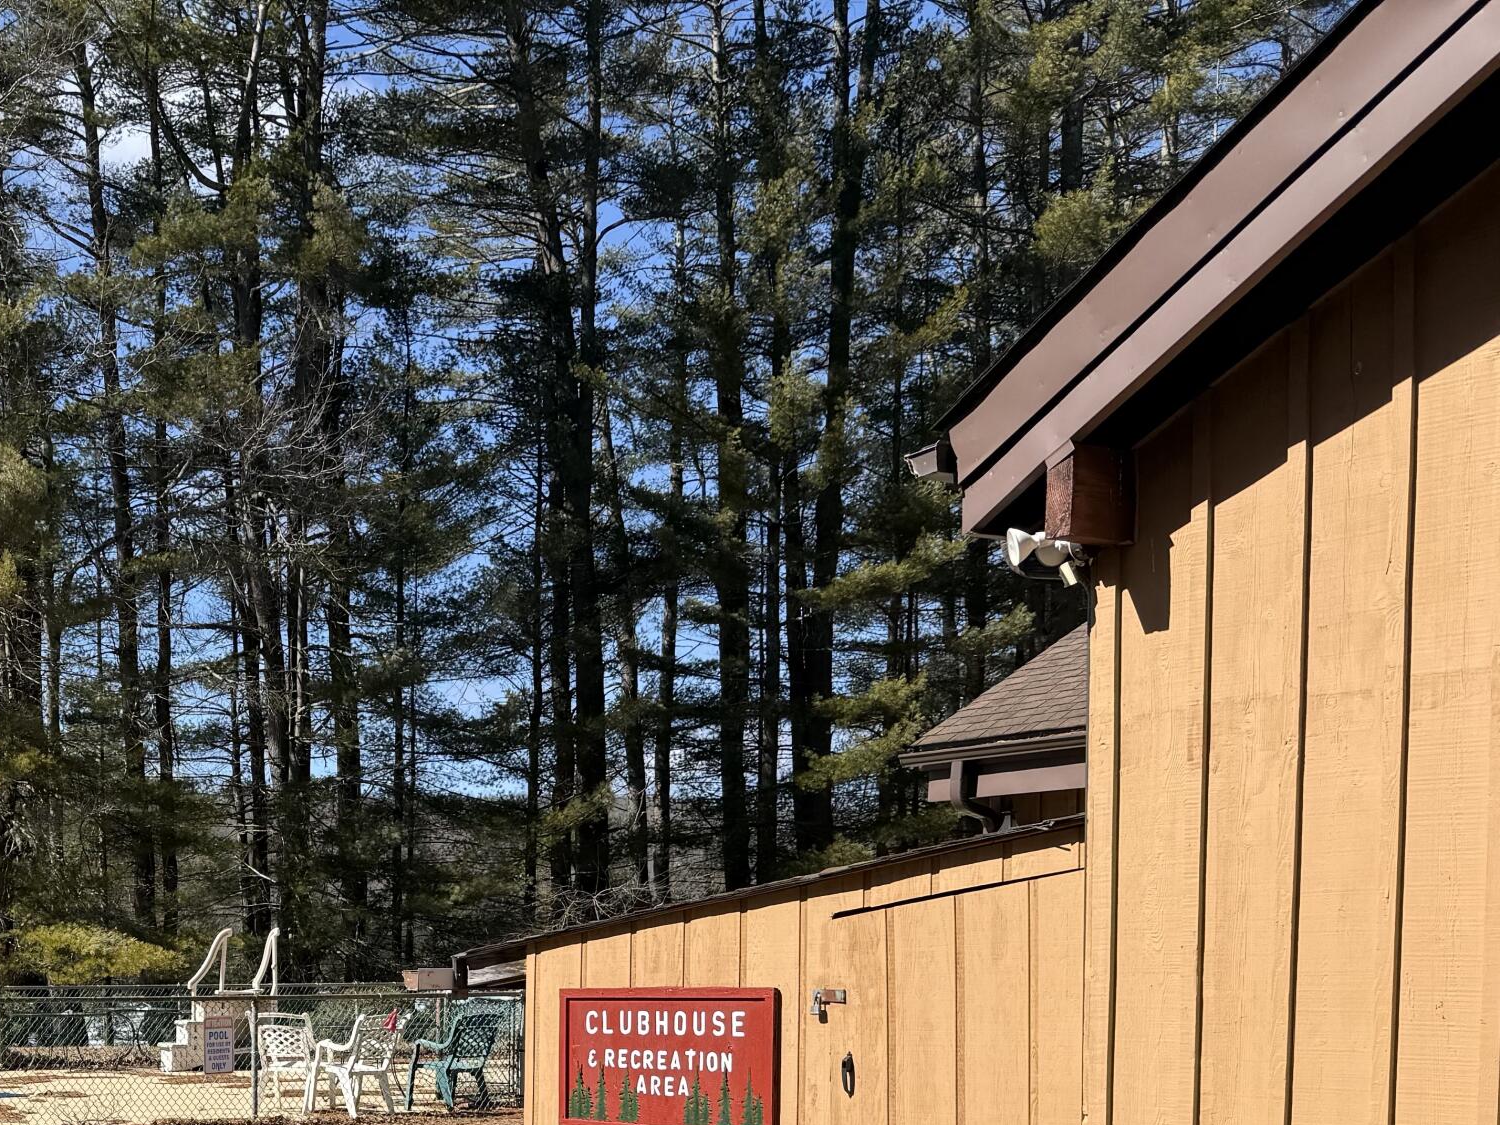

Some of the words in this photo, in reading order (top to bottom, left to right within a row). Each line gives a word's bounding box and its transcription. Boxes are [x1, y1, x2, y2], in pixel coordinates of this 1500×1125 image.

[584, 1010, 746, 1037] CLUBHOUSE
[208, 1031, 229, 1040] POOL
[211, 1062, 226, 1070] ONLY
[587, 1049, 597, 1068] &
[604, 1048, 733, 1072] RECREATION
[636, 1074, 690, 1097] AREA
